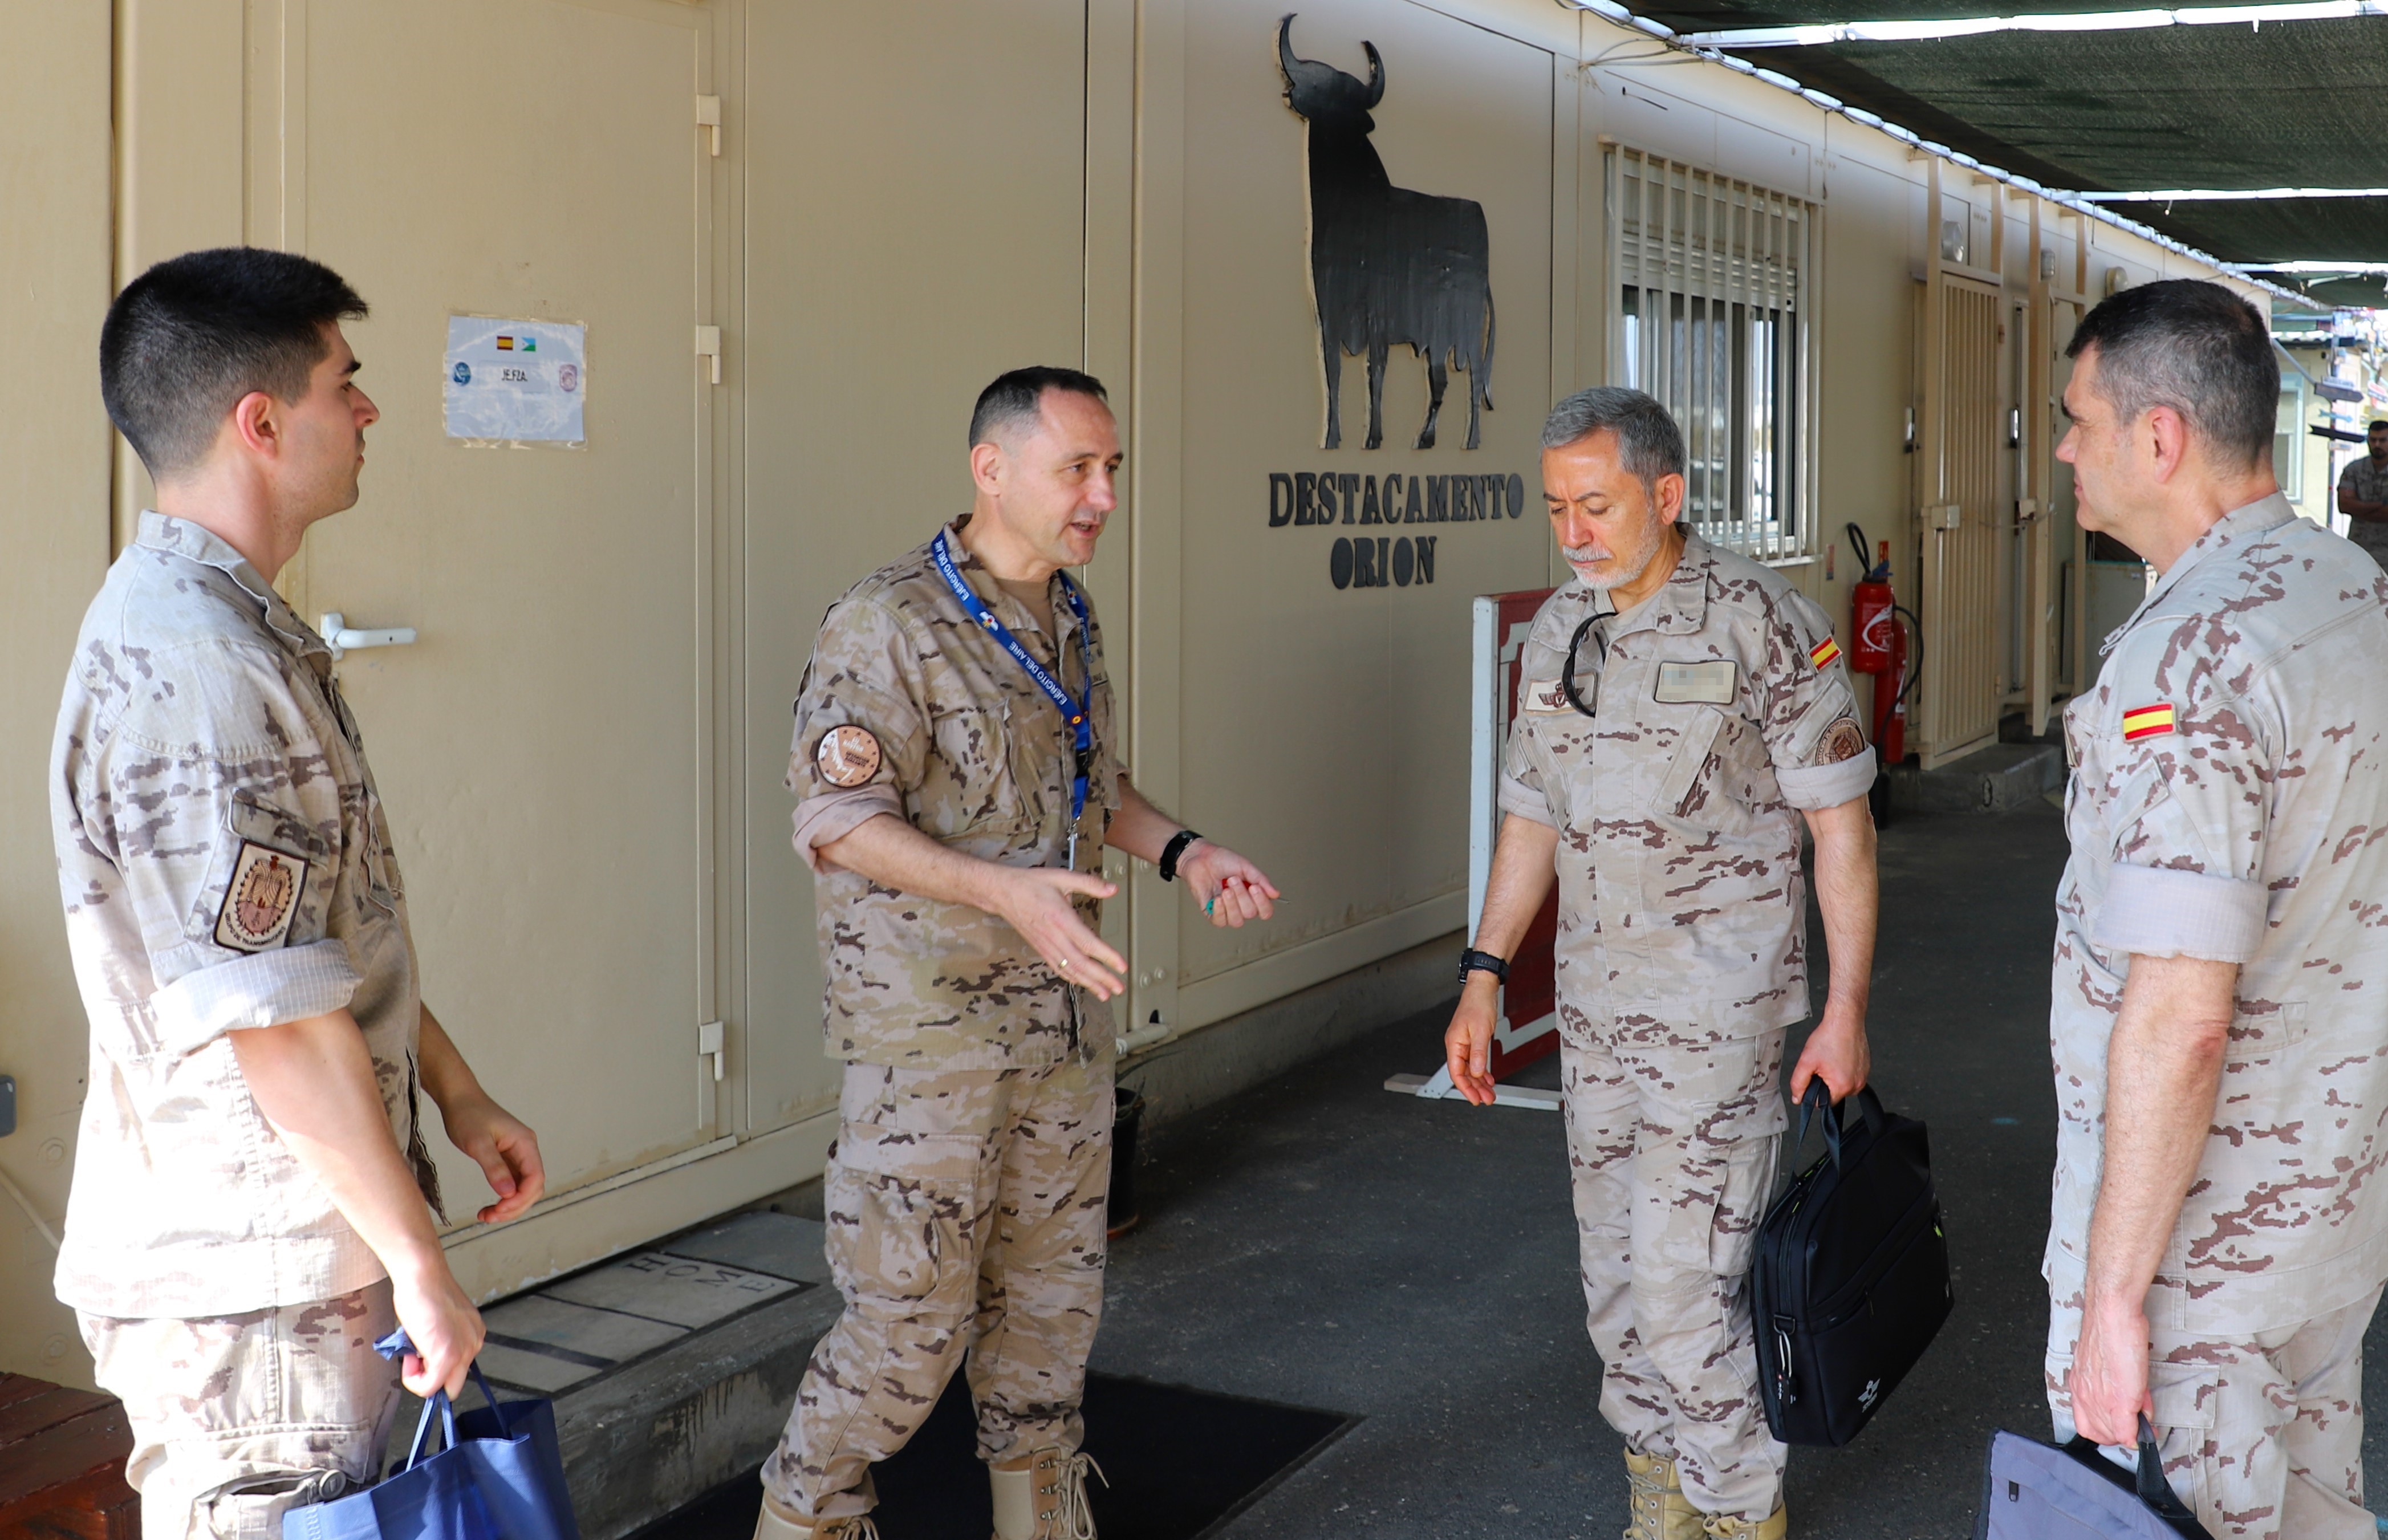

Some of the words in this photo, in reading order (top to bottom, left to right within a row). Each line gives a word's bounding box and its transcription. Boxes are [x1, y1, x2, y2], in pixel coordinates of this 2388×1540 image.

[1269, 472, 1524, 527] DESTACAMENTO
[937, 550, 948, 566] DEL
[1330, 535, 1437, 590] ORION
[943, 563, 969, 601] EJÉRCITO
[1008, 640, 1028, 660] AIRE
[1026, 659, 1041, 674] DEL
[1035, 669, 1067, 705] EJÉRCITO
[625, 1256, 775, 1293] HOME
